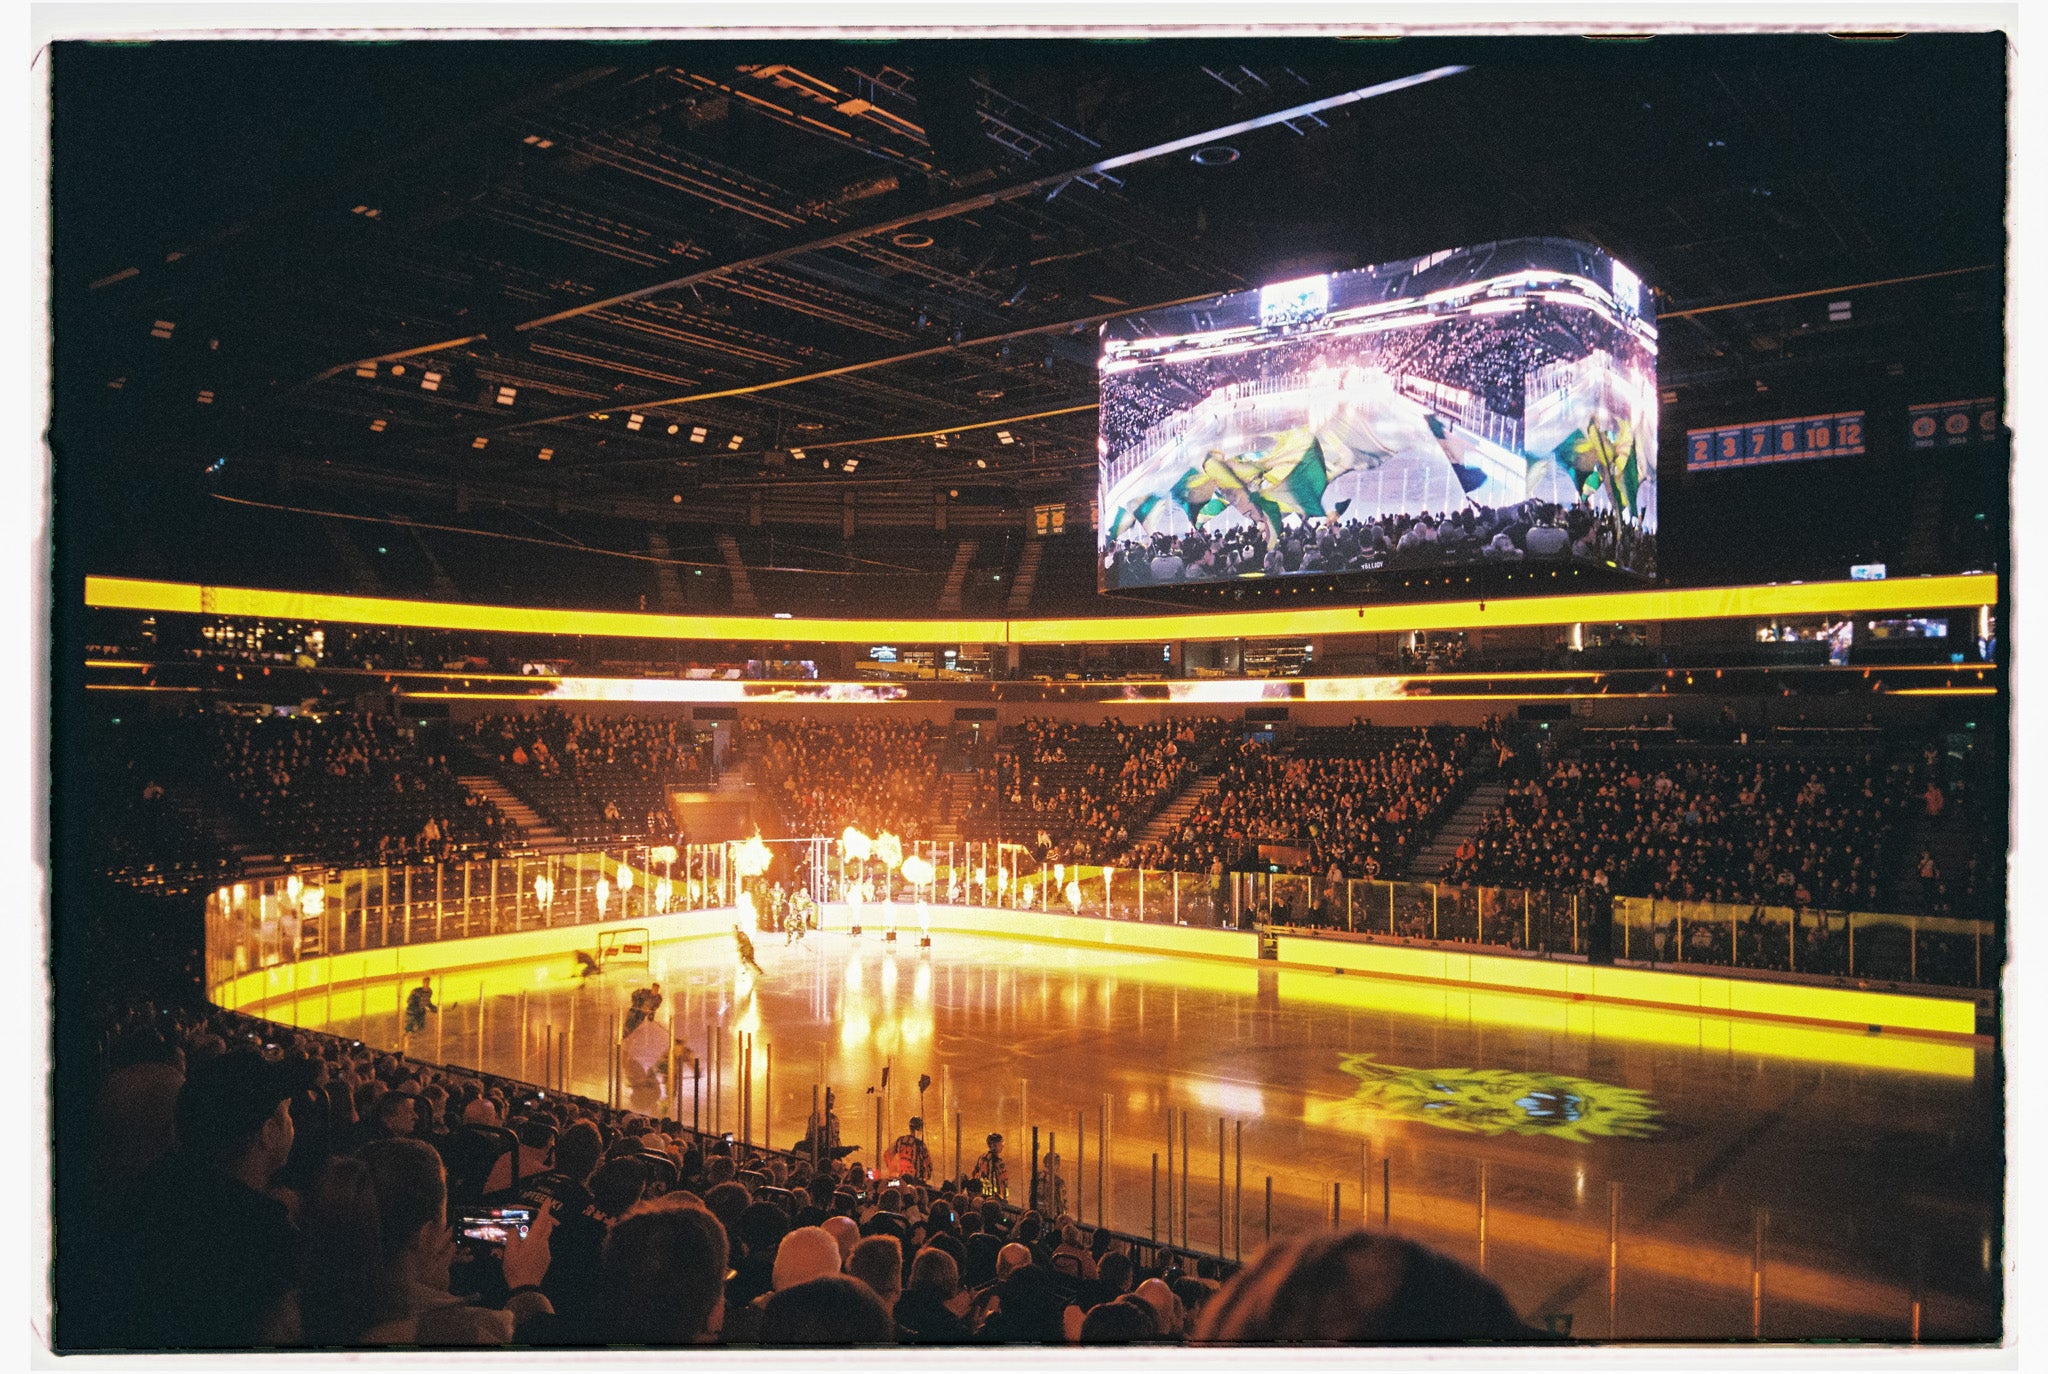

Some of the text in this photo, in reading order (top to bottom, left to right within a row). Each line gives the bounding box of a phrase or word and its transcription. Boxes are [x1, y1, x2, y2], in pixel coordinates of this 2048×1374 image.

[1752, 433, 1765, 454] 7
[1781, 431, 1794, 451] 8
[1806, 427, 1829, 449] 10
[1837, 423, 1861, 445] 12
[1695, 440, 1708, 460] 2
[1723, 437, 1736, 458] 3
